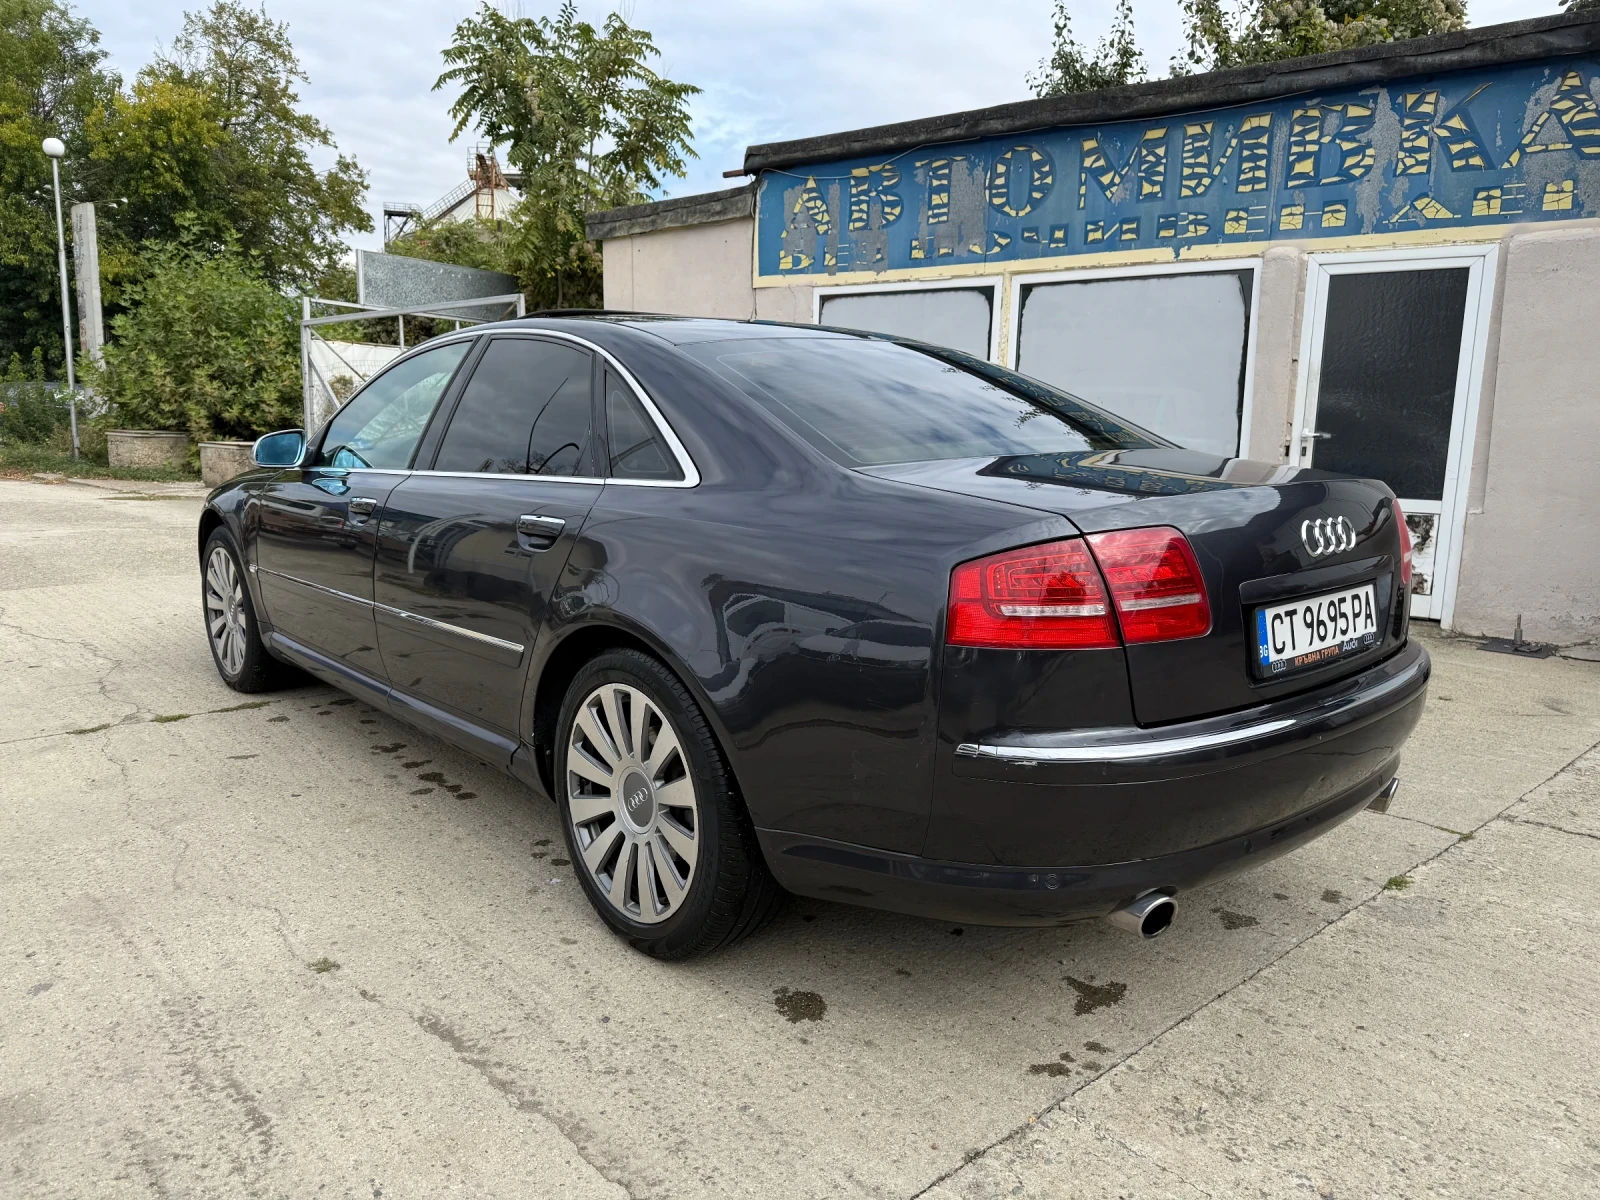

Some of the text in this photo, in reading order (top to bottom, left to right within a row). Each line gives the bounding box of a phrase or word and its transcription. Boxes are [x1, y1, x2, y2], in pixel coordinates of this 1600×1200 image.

[1303, 596, 1350, 647] 9695
[1294, 645, 1340, 667] КРЪВНА ГРУПА
[1342, 638, 1358, 652] Audi
